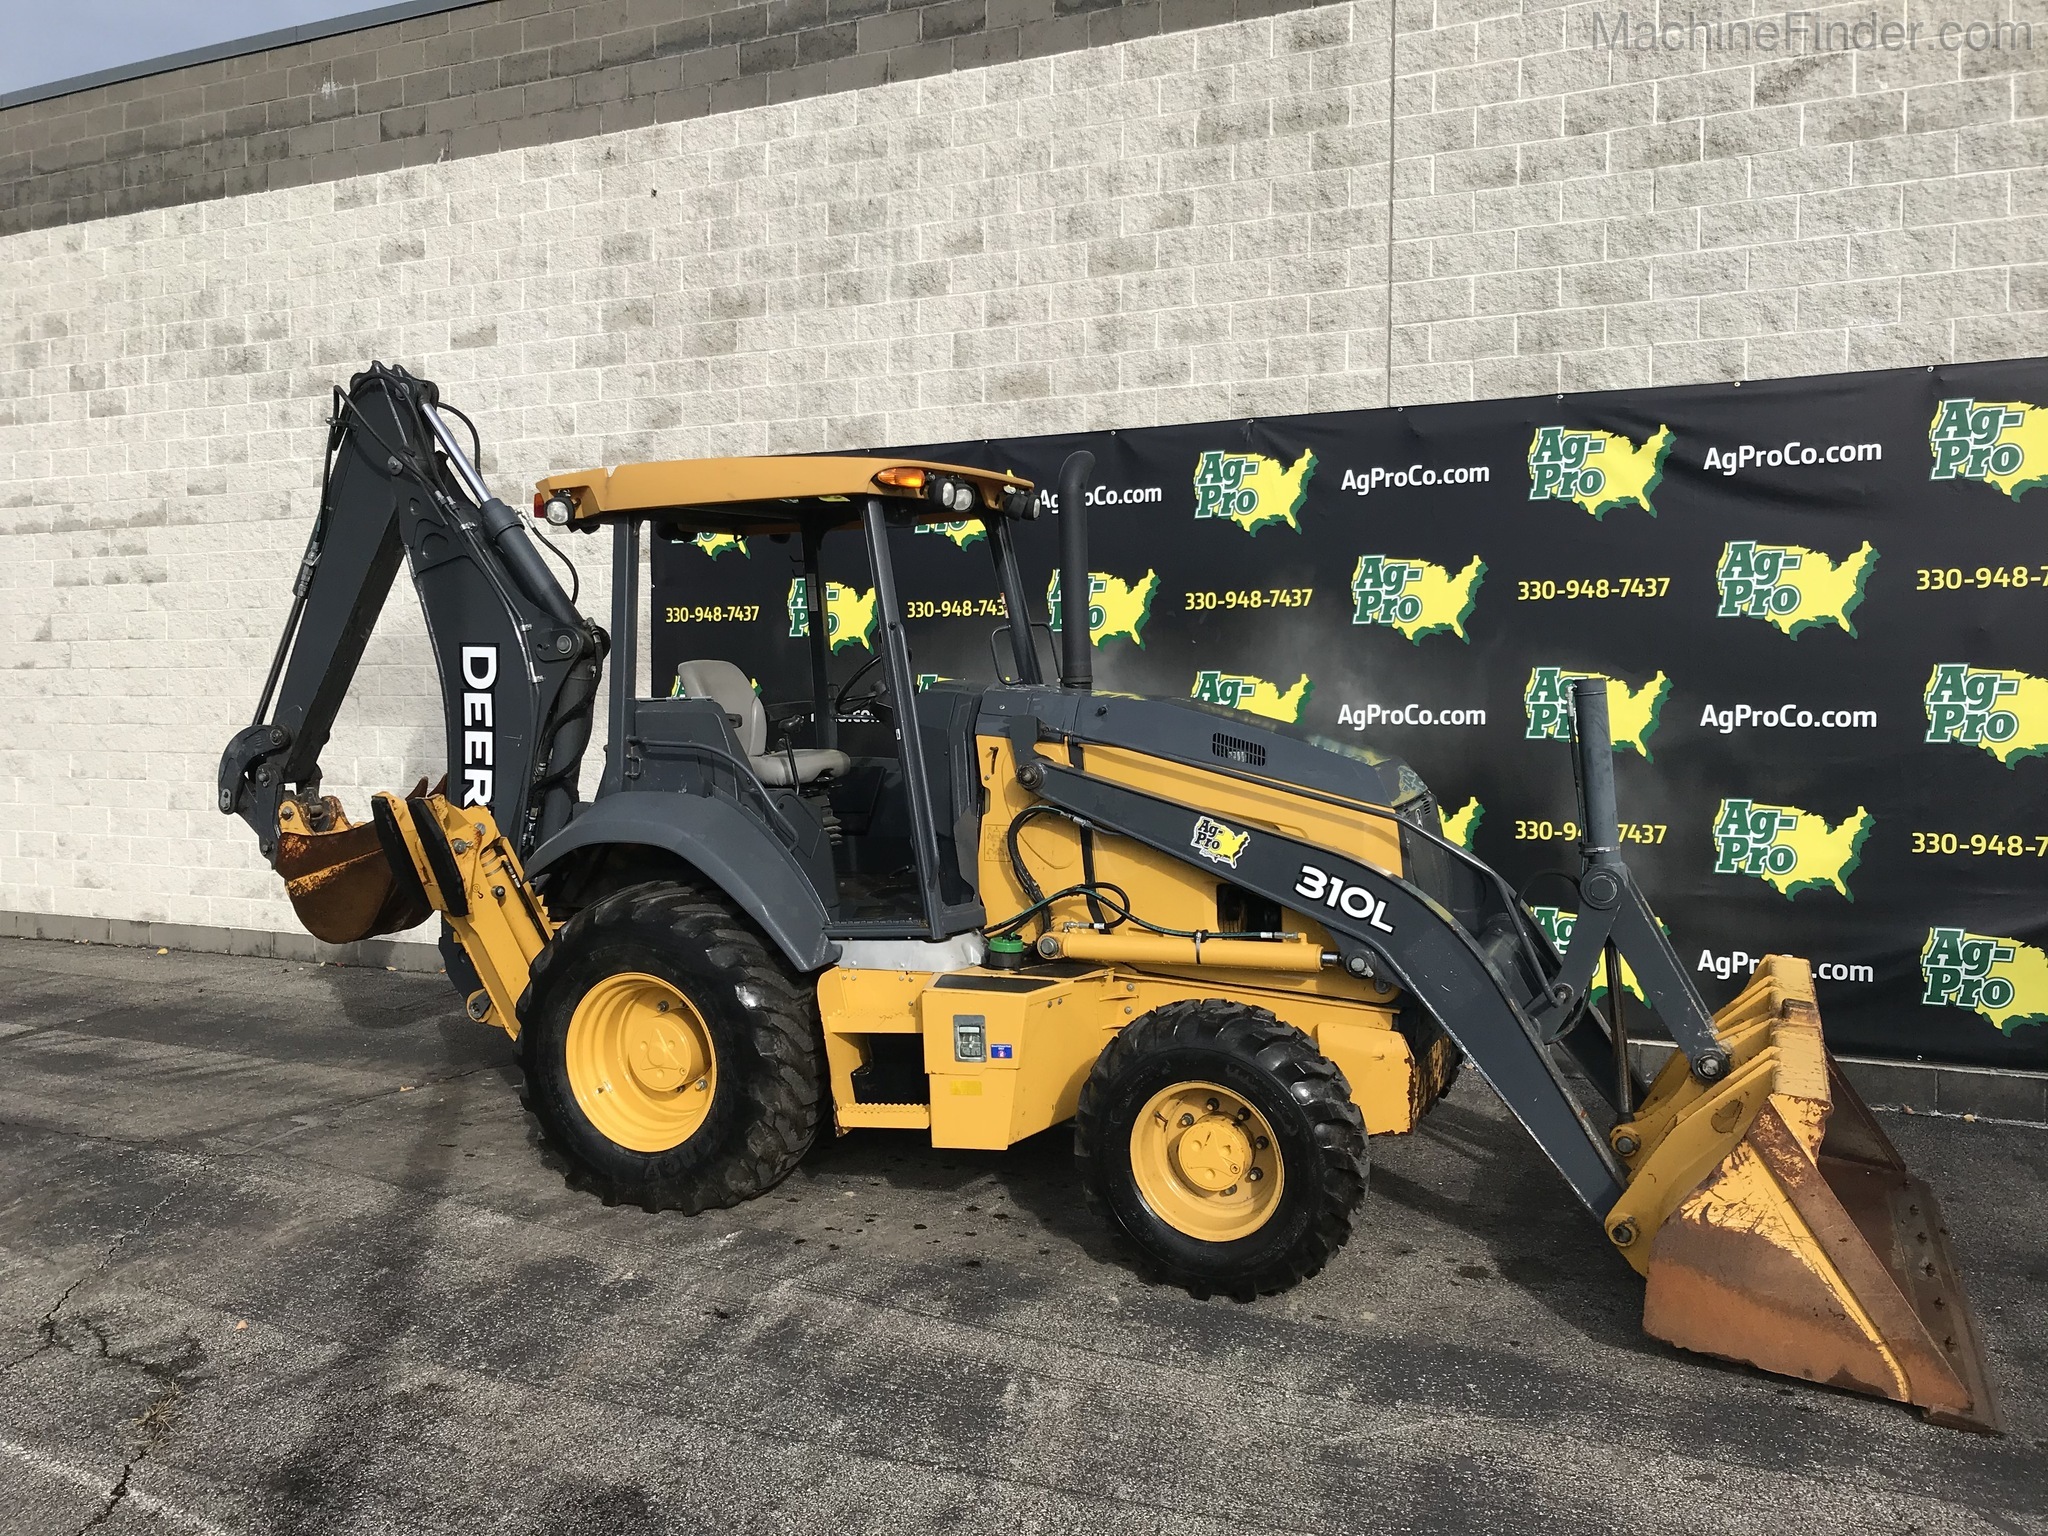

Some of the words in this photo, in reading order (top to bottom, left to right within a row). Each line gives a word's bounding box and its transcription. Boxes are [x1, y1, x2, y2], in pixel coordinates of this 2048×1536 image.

[1932, 398, 2024, 446] Ag-
[1530, 426, 1605, 471] Ag-
[1703, 442, 1882, 476] AgProCo.com
[1930, 438, 2024, 480] Pro
[1195, 451, 1258, 491] Ag-
[1341, 465, 1490, 496] AgProCo.com
[1529, 462, 1605, 500] Pro
[1041, 486, 1162, 514] AgoCo.com
[1194, 483, 1258, 518] Pro
[1353, 555, 1422, 597] Ag-
[1718, 541, 1801, 587] Ag-
[1185, 589, 1313, 610] 330-948-7437
[1352, 589, 1422, 625] Pro
[1518, 578, 1670, 600] 330-948-7437
[1717, 578, 1801, 617] Pro
[666, 605, 759, 623] 330-948-7437
[1926, 663, 2019, 712] Ag-
[1337, 703, 1486, 731] AgProCo.com
[1700, 704, 1877, 734] AgProCo.com
[1926, 703, 2019, 743] Pro
[1194, 831, 1220, 850] Pro
[1198, 818, 1224, 838] Ag-
[1715, 799, 1798, 846] Ag-
[1715, 836, 1798, 874] Pro
[1295, 865, 1394, 934] 310L
[1923, 928, 2015, 978] Ag-
[1923, 966, 2015, 1008] Pro
